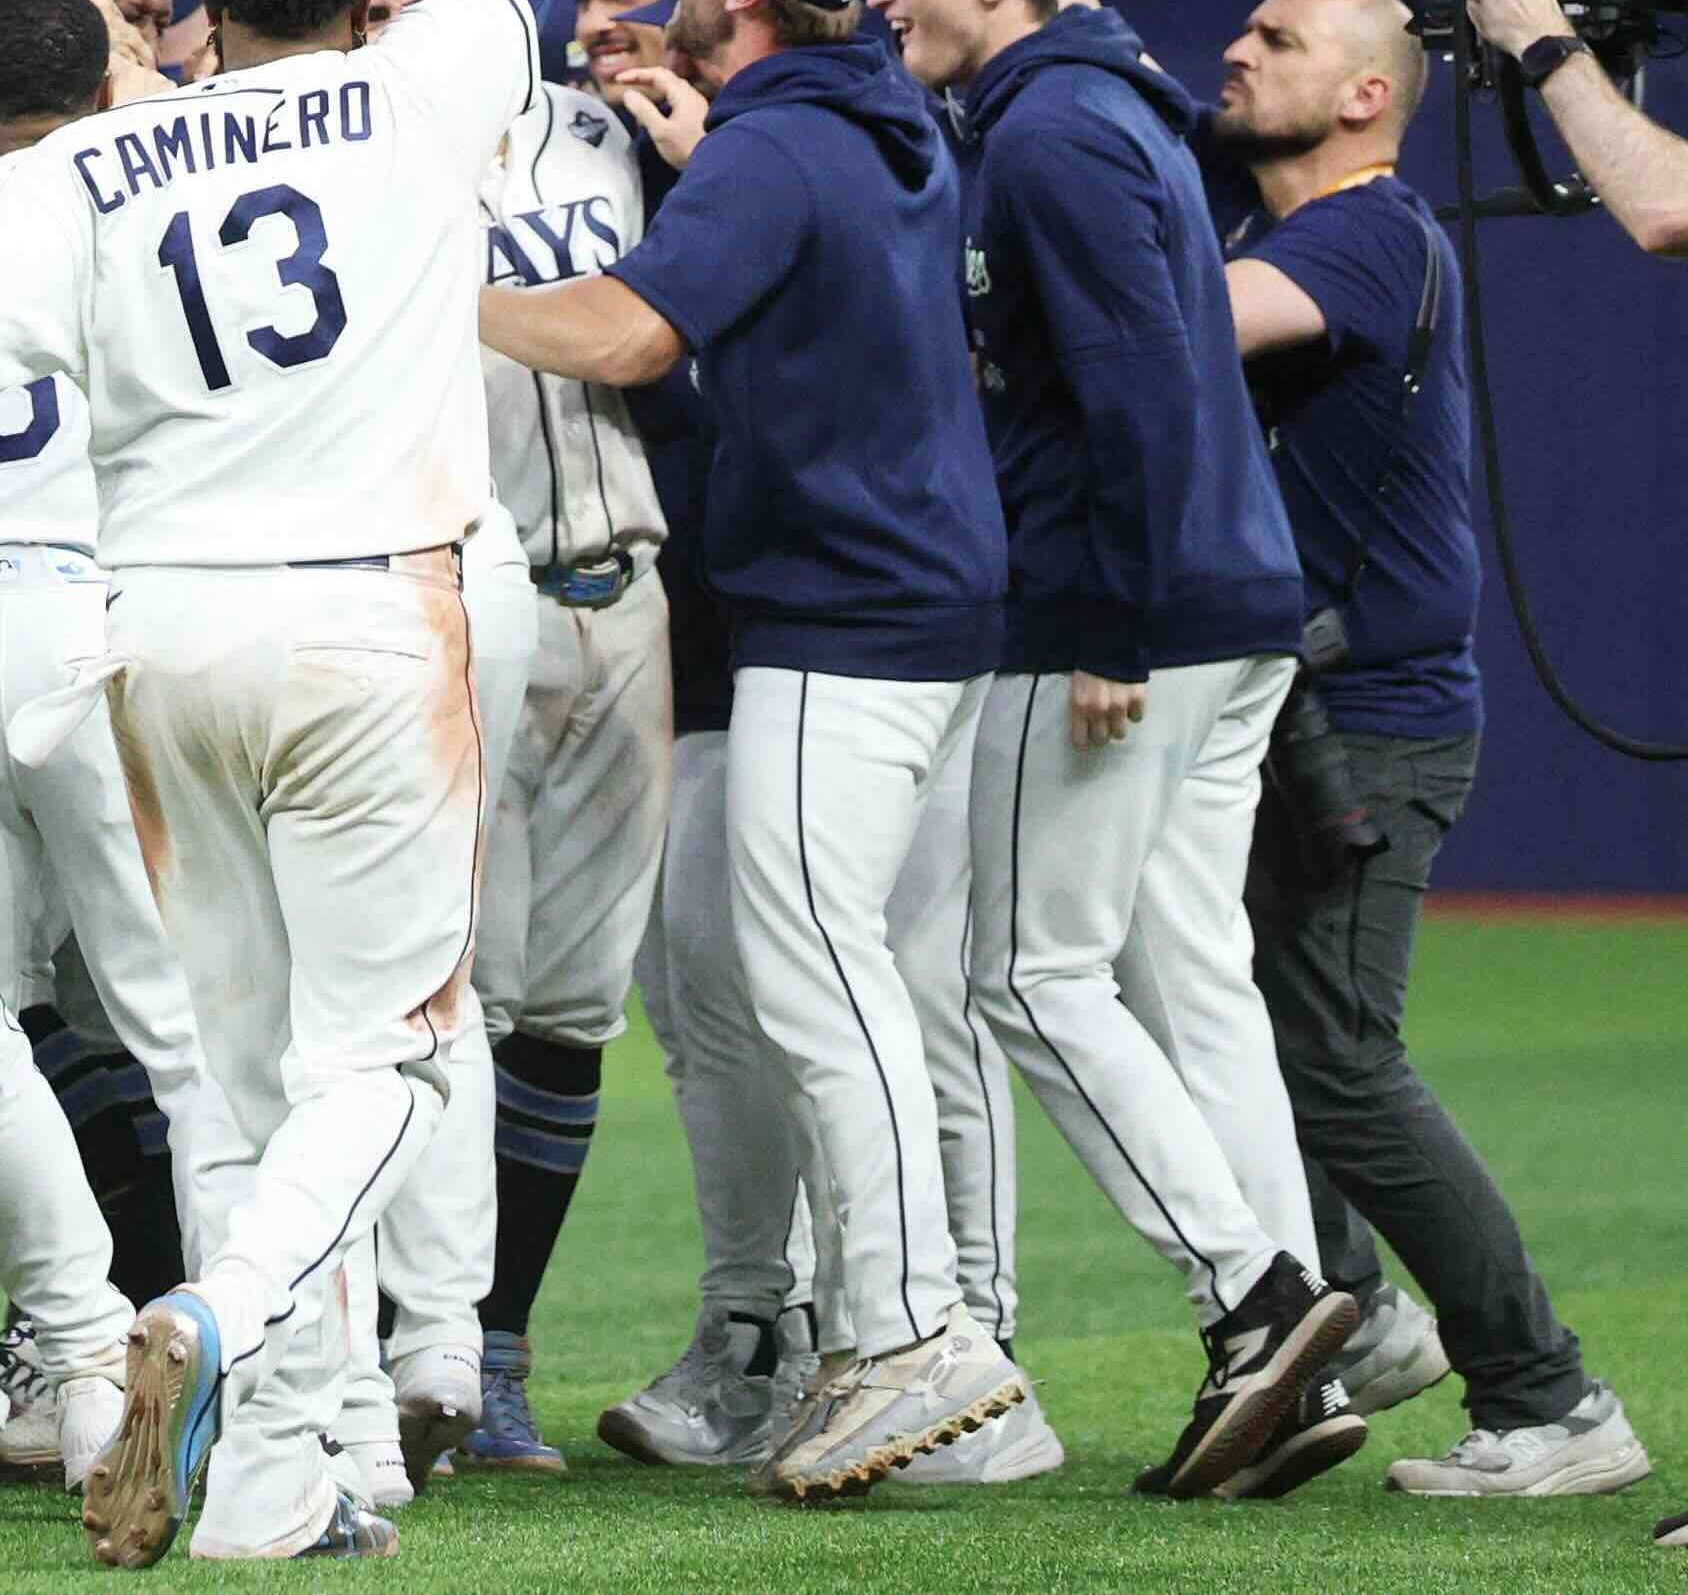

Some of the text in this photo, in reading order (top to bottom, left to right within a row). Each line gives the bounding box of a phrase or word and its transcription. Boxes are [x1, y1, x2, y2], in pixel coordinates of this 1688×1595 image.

[74, 81, 372, 215] CAMINERO
[157, 183, 348, 391] 13
[486, 195, 621, 288] AYS
